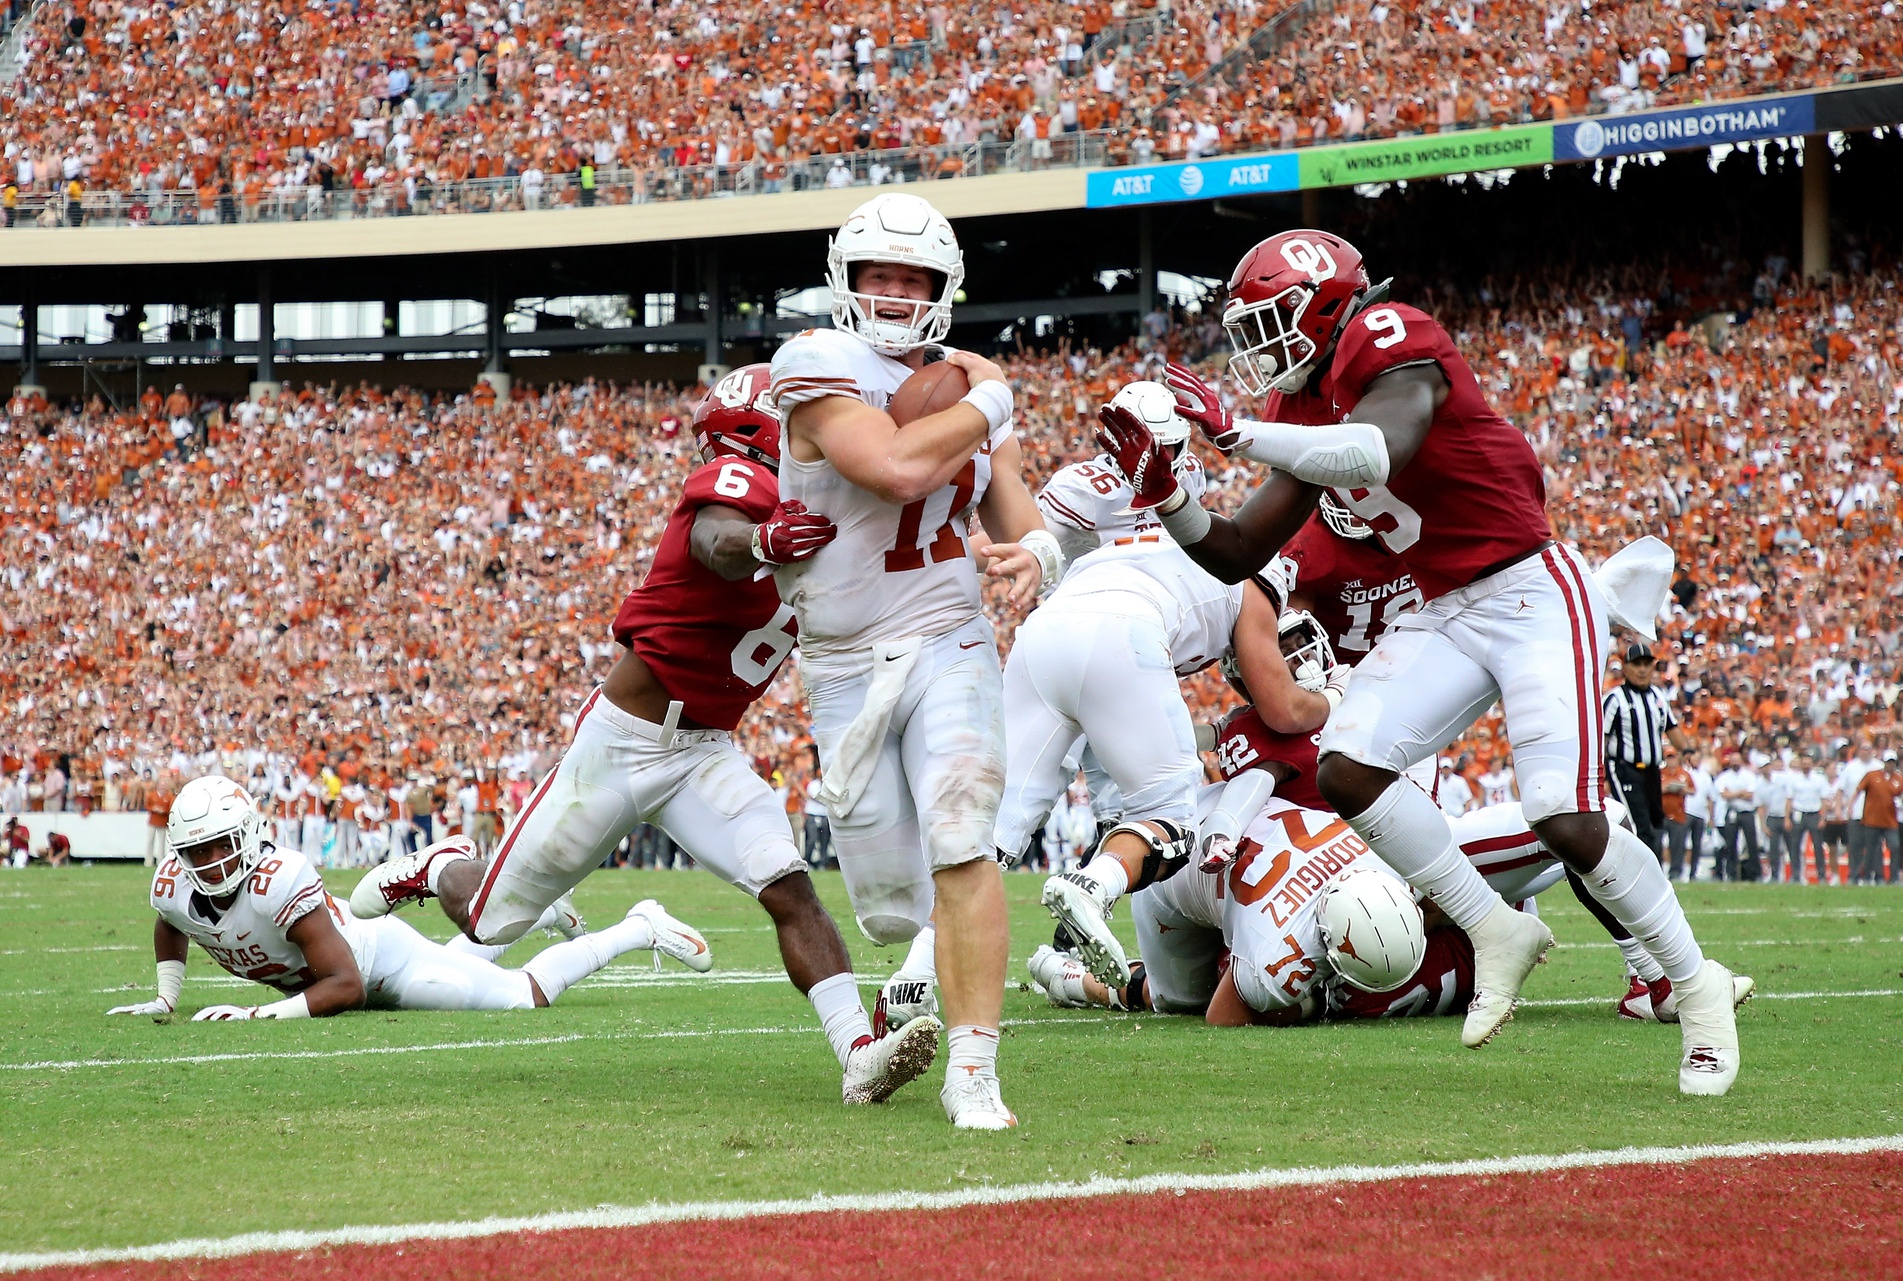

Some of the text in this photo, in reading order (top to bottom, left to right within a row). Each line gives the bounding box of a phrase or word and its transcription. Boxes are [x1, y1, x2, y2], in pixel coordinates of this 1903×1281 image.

[1604, 107, 1779, 146] HIGGINBOTHAM
[1346, 137, 1532, 170] WINSTAR WORLD RESORT
[1112, 175, 1155, 196] AT&T
[1228, 164, 1272, 186] AT&T
[889, 244, 914, 254] HORNS
[1280, 239, 1337, 282] OU
[1364, 308, 1407, 349] 9
[713, 462, 755, 498] 6
[1074, 463, 1122, 495] 56
[1131, 450, 1151, 496] BOOMER
[885, 459, 976, 573] 11
[1343, 578, 1364, 590] XII
[731, 603, 797, 687] 6
[1217, 734, 1260, 777] 42
[154, 858, 182, 900] 26
[247, 856, 284, 897] 26
[1057, 872, 1100, 896] NIKE
[202, 943, 269, 967] EXAS
[1264, 933, 1317, 999] 72
[889, 982, 928, 1006] NIKE
